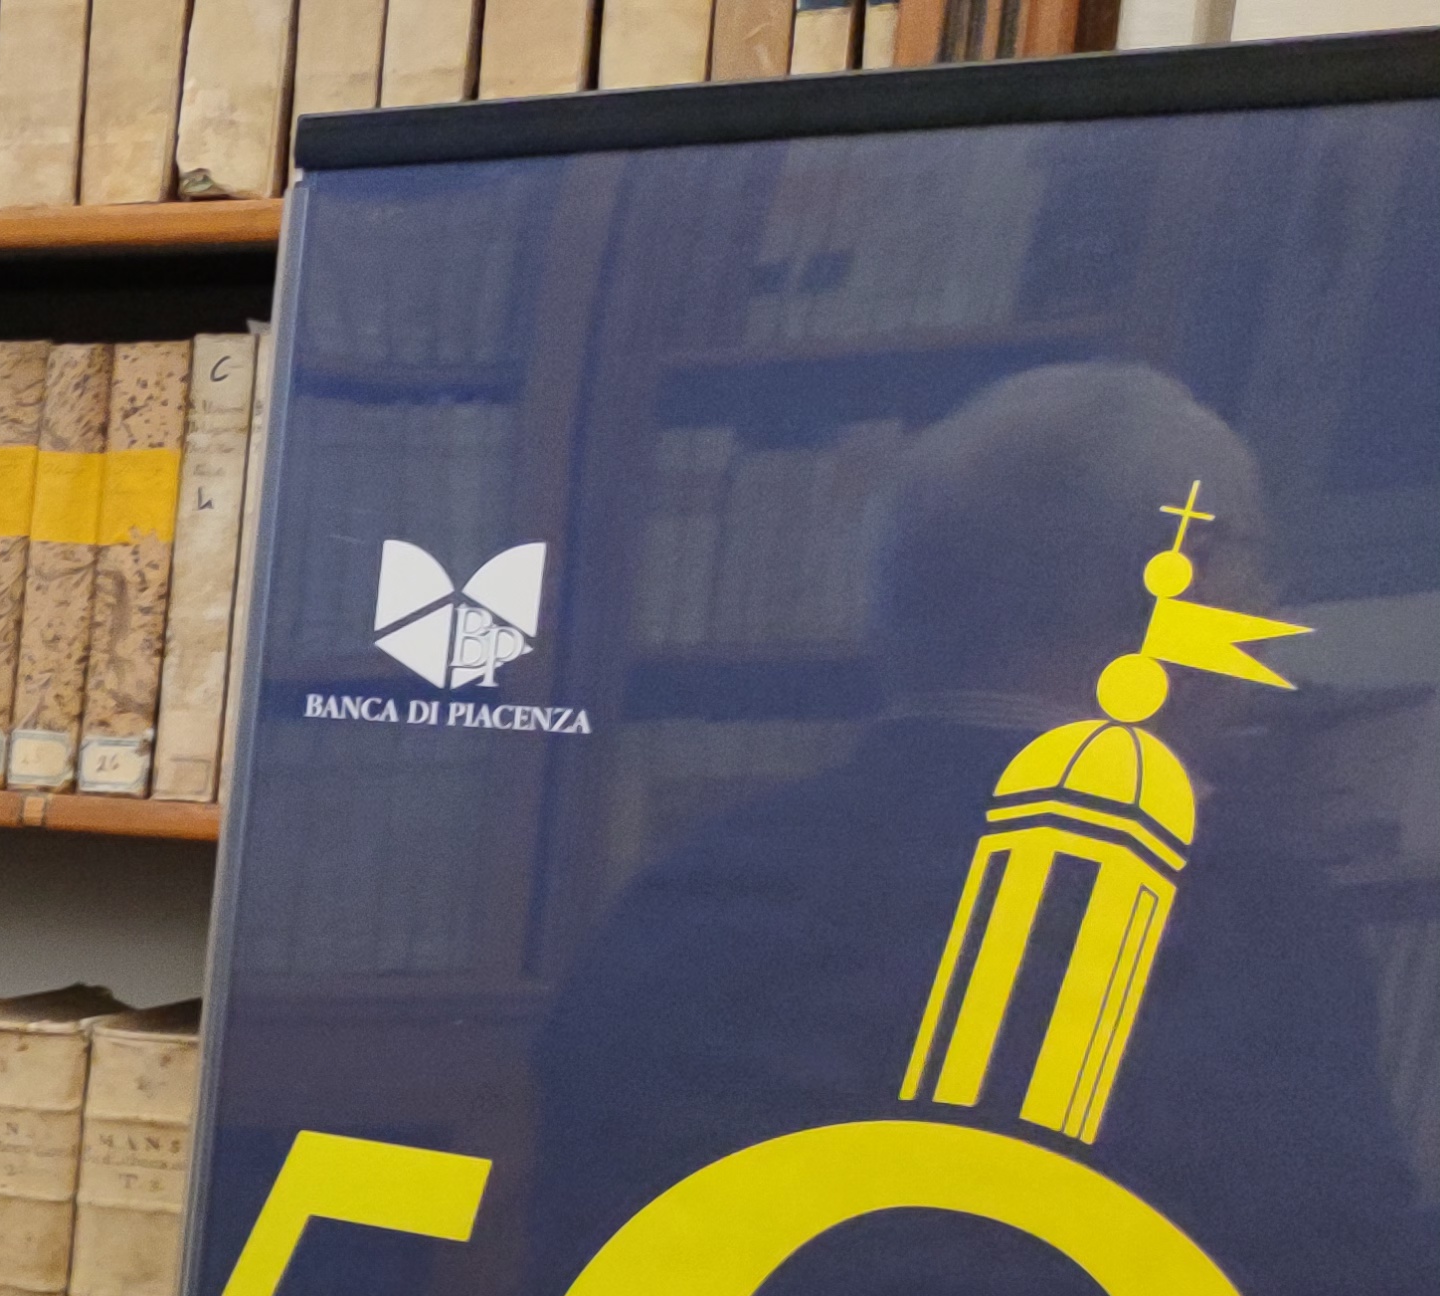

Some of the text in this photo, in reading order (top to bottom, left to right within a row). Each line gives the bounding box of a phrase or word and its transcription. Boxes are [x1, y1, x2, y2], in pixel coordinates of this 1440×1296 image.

[303, 693, 592, 735] BANCA DI PIACENZA
